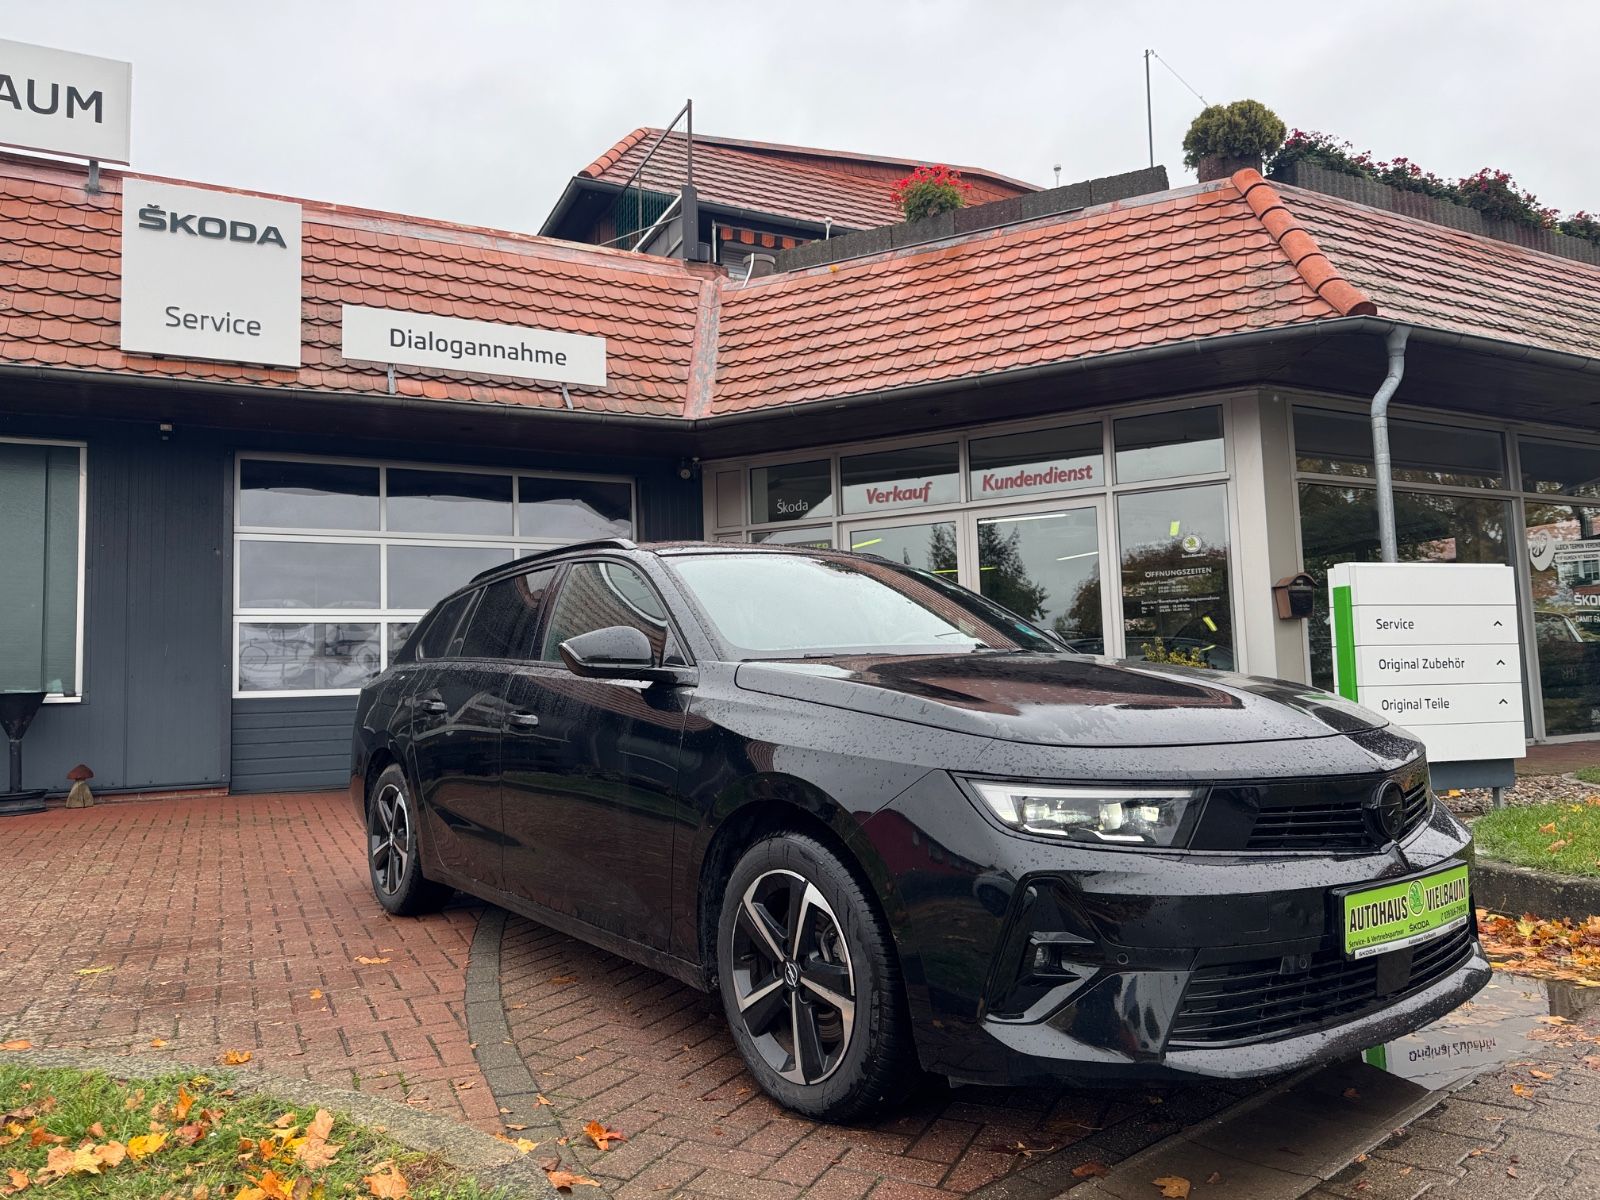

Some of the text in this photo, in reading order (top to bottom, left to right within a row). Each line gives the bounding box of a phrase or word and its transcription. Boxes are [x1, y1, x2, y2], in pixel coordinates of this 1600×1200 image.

[138, 203, 287, 249] ŠKODA
[165, 306, 262, 336] Service
[390, 328, 567, 366] Dialogannahme
[982, 465, 1093, 491] Kundendienst
[866, 481, 933, 504] Verkauf
[777, 499, 809, 514] Škoda
[1144, 567, 1212, 578] ÖFFNUNGSZEITEN
[1376, 618, 1415, 630] Service
[1378, 658, 1465, 672] Original Zubehör
[1381, 698, 1450, 713] Original Teile
[1350, 896, 1408, 932] AUTOHAUS
[1426, 878, 1466, 910] VIELBAUM
[1409, 920, 1430, 932] ŠKODA
